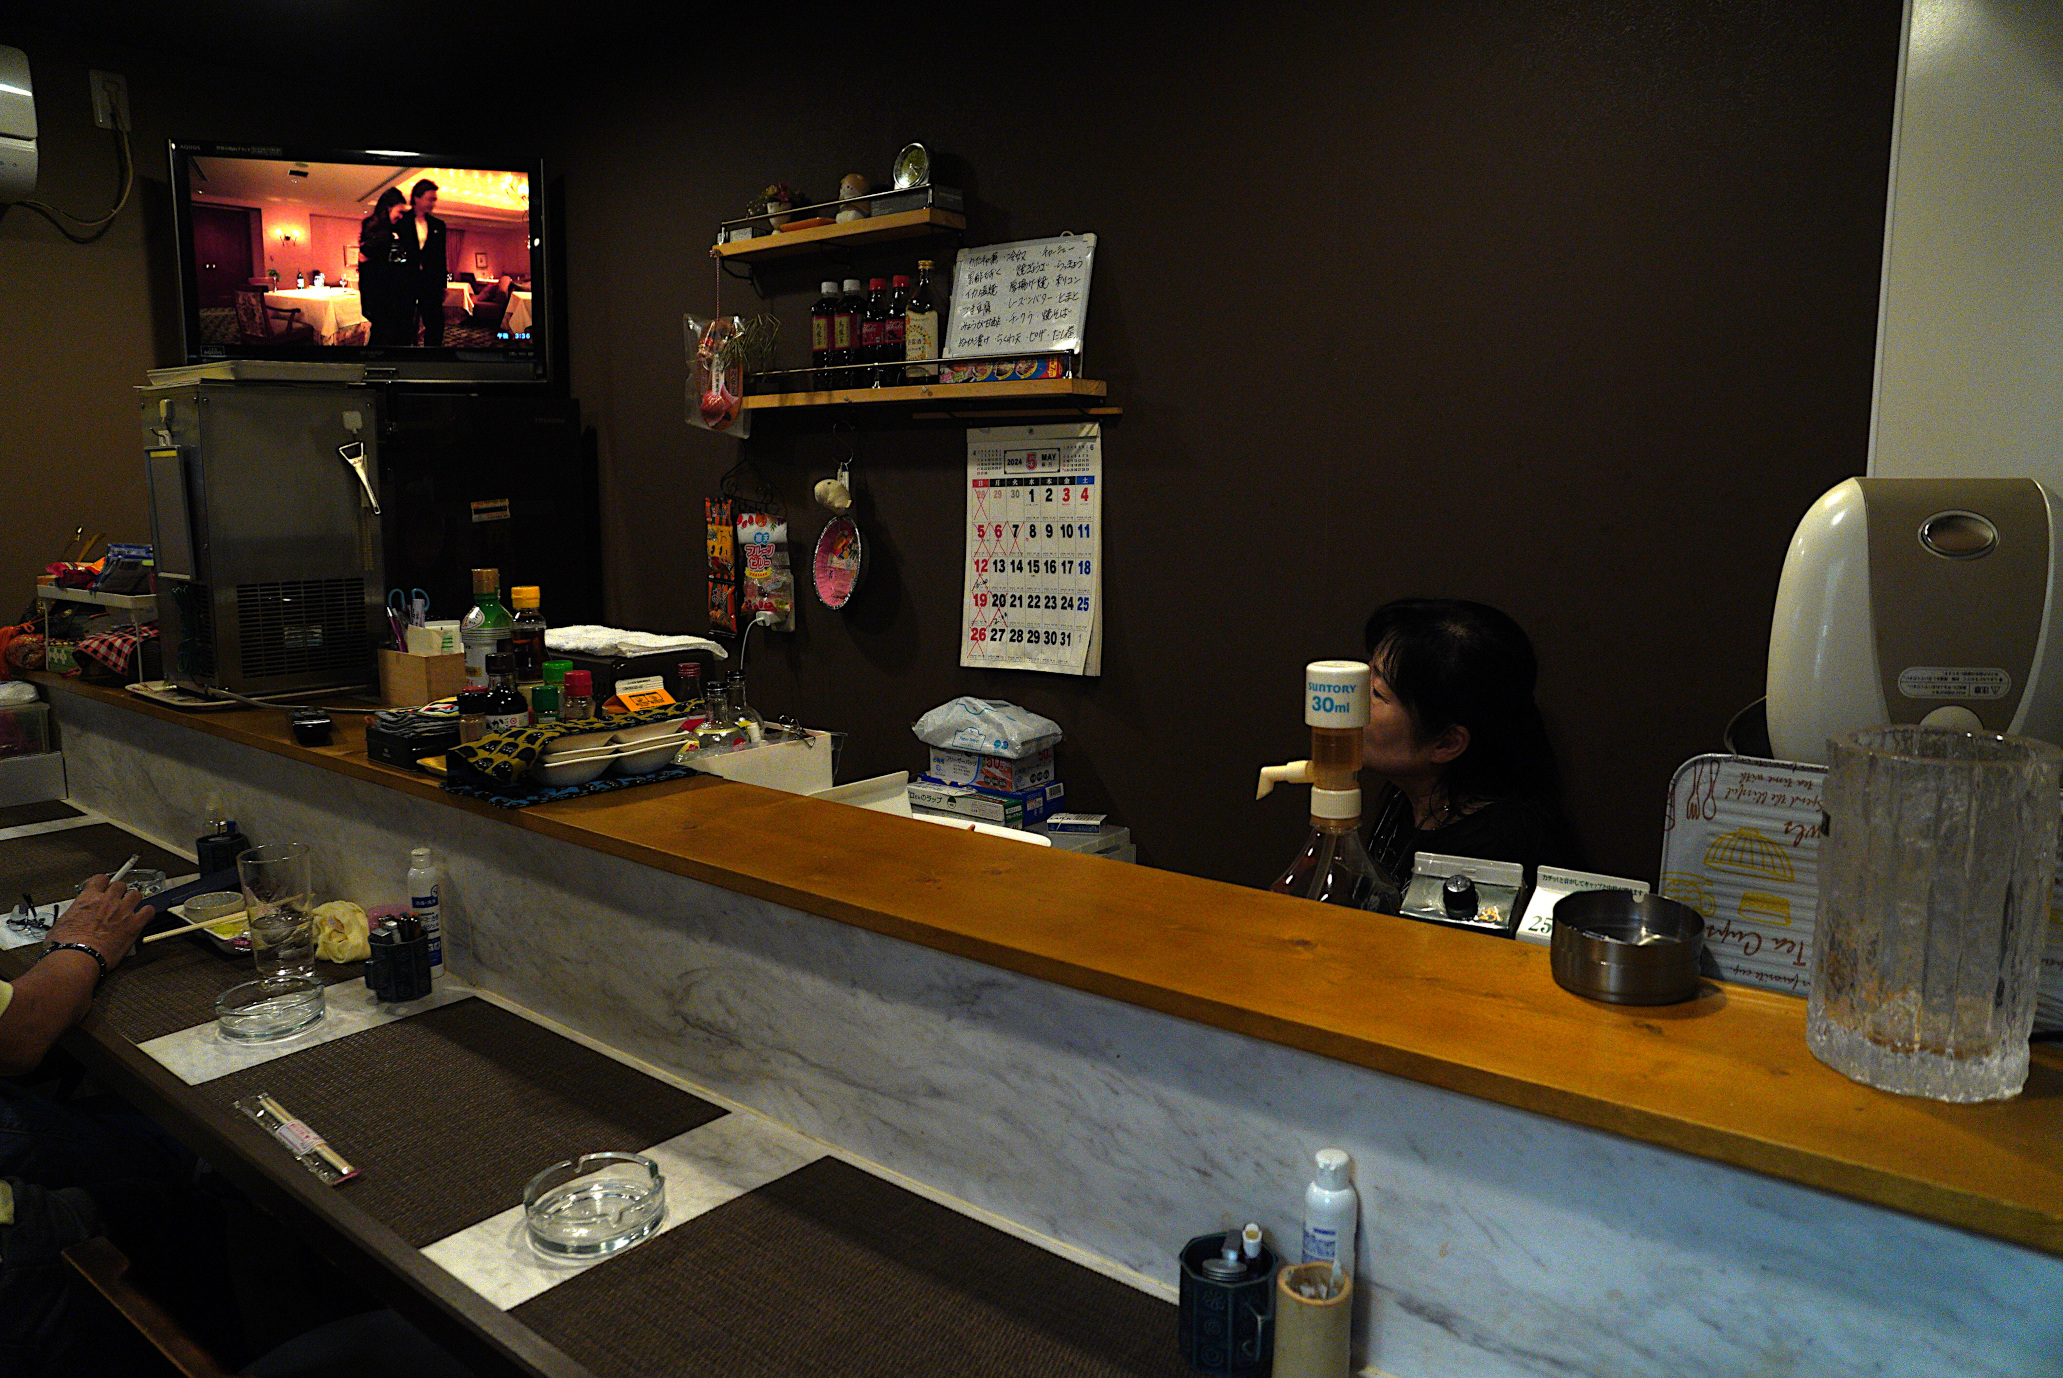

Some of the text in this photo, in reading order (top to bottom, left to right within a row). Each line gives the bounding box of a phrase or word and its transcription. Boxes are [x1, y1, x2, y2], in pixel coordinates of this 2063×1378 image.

[1025, 452, 1037, 470] 5
[1064, 477, 1070, 485] 金
[994, 490, 1002, 498] 29
[1011, 489, 1020, 498] 30
[1029, 489, 1034, 502] 1
[1045, 488, 1053, 502] 2
[1062, 488, 1070, 502] 3
[1081, 488, 1088, 501] 4
[977, 524, 1090, 539] 5 6 7 8 9 10 11
[748, 556, 771, 571] ゼリー
[974, 559, 1091, 574] 12 13 14 15 16 17 18
[973, 593, 1090, 611] 19 20 21 22 23 24 25
[971, 627, 986, 641] 26
[990, 628, 1006, 642] 27
[1009, 629, 1024, 643] 28
[1027, 630, 1041, 644] 29
[1043, 631, 1057, 645] 30
[1060, 631, 1071, 646] 31
[1308, 682, 1356, 693] SUNTORY
[1312, 696, 1350, 713] 30ml
[1784, 821, 1821, 848] wls
[1704, 919, 1807, 967] Tea Cups
